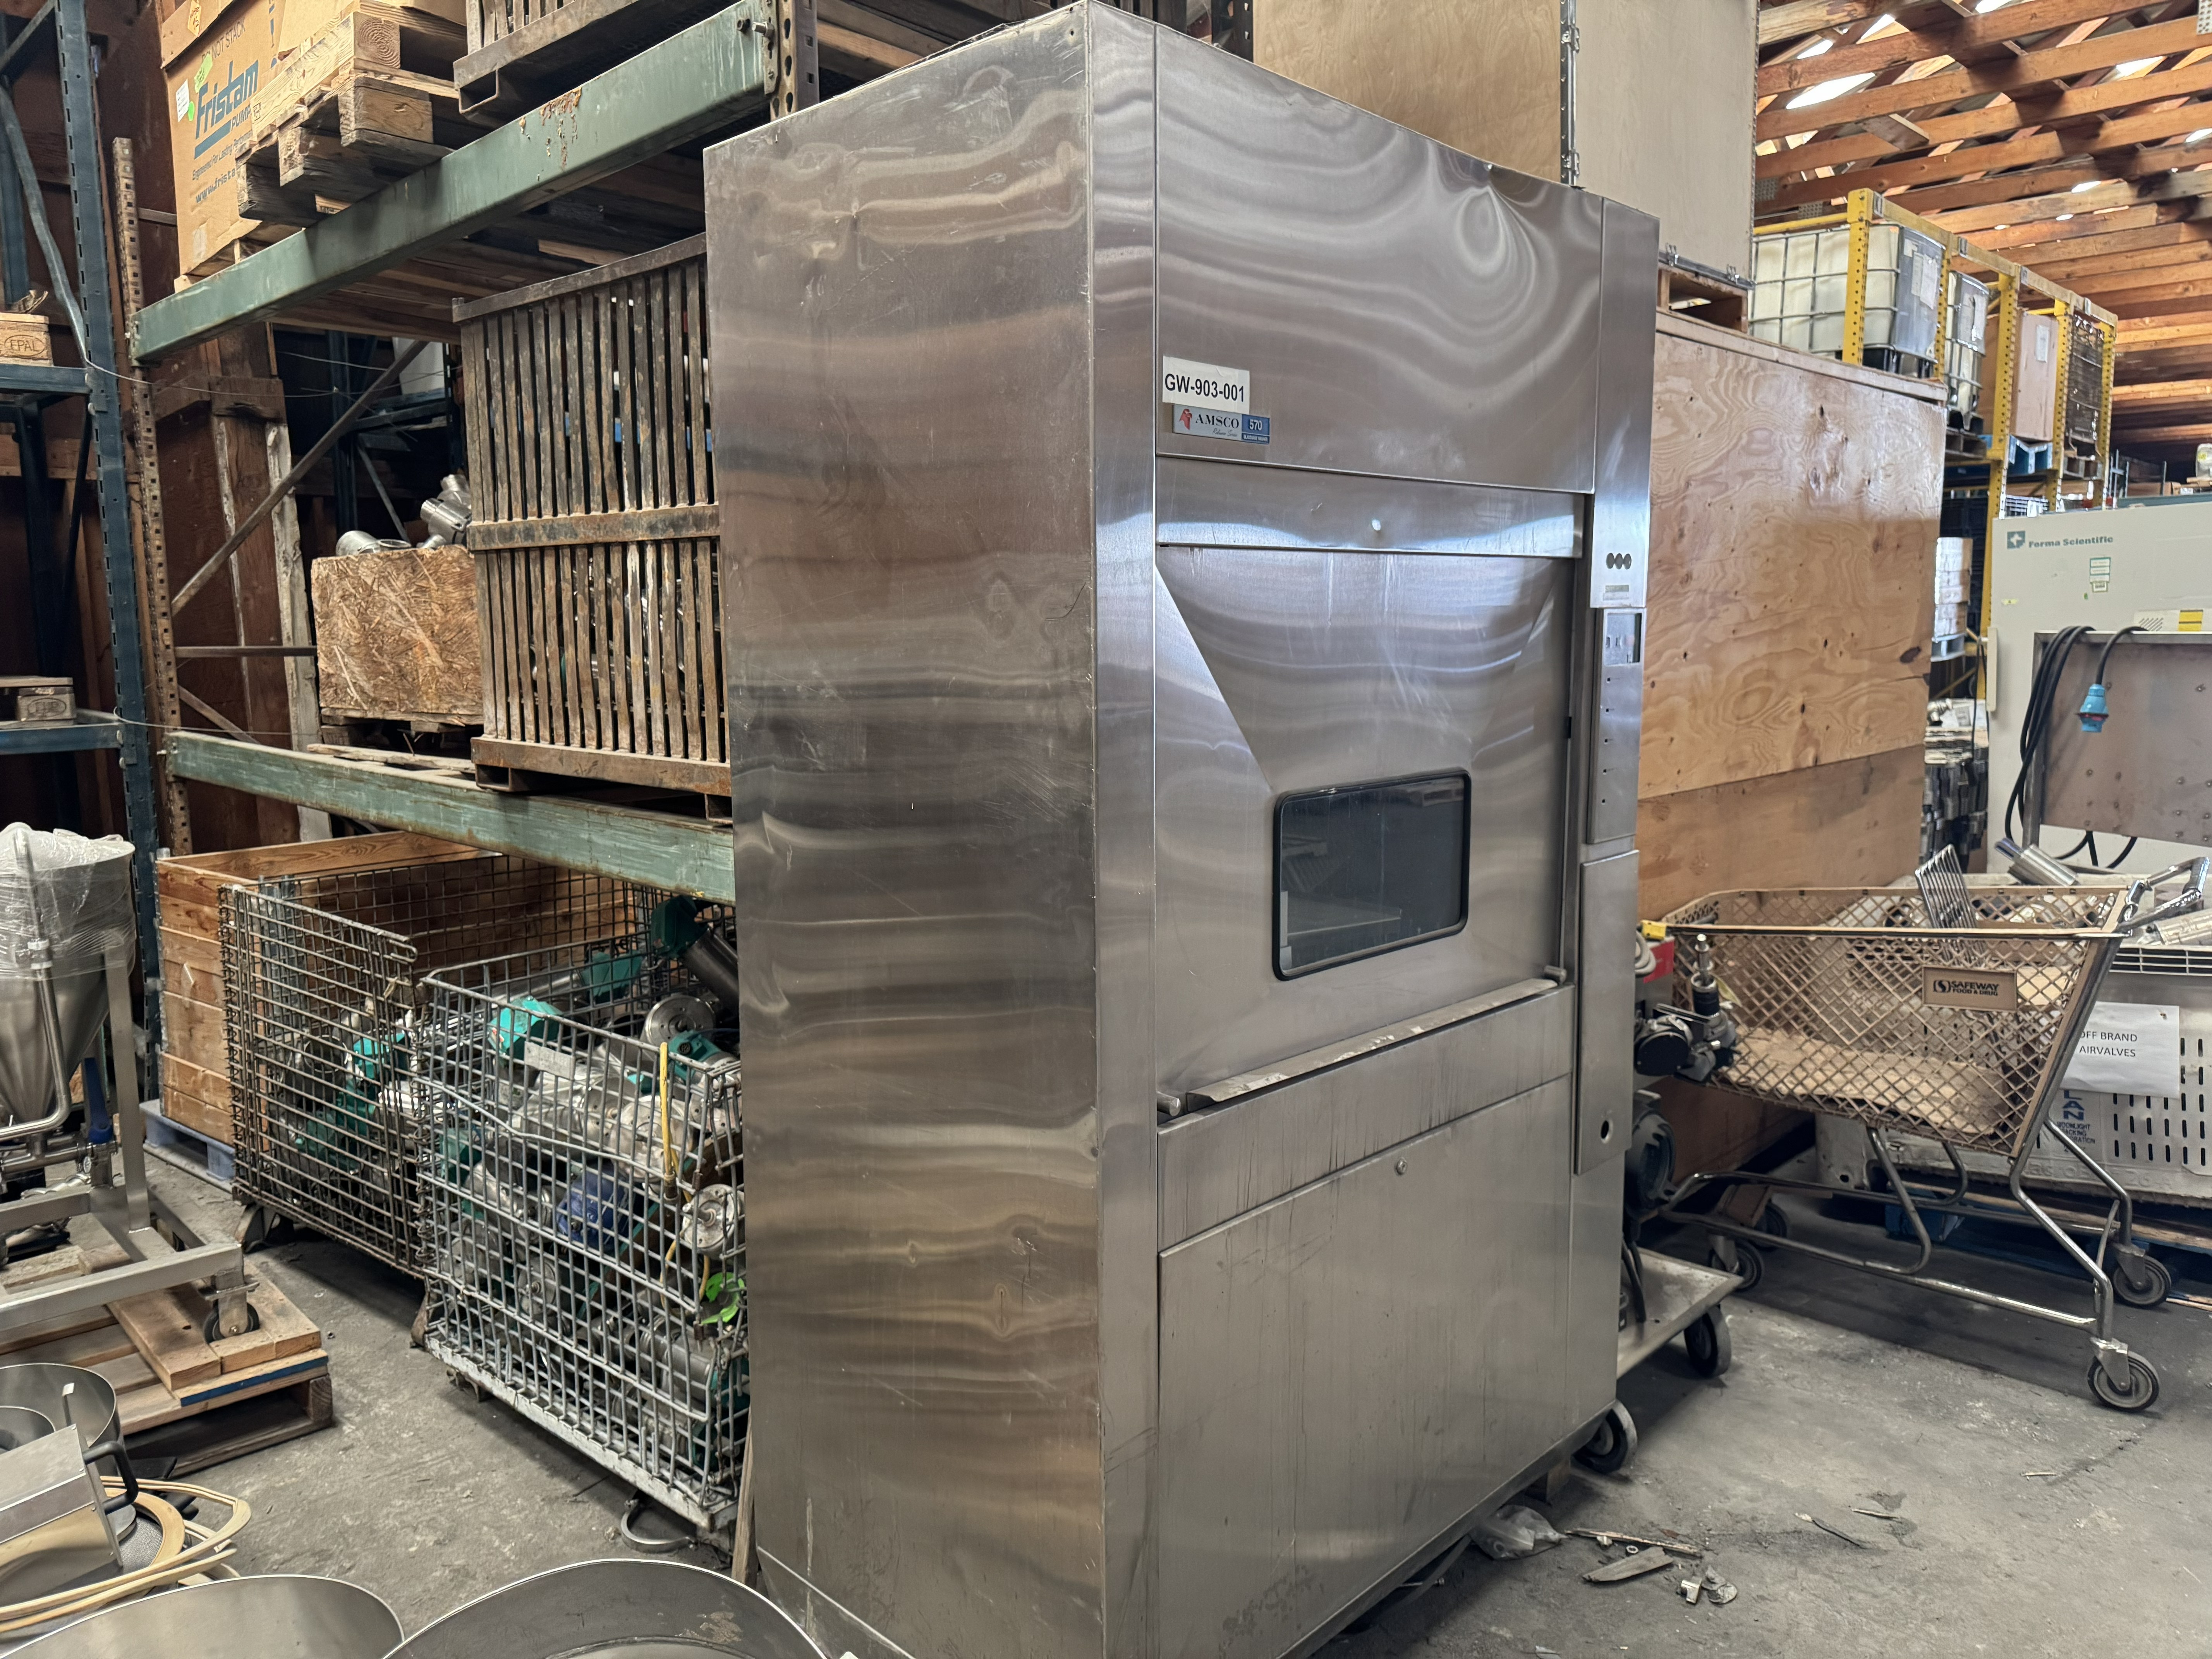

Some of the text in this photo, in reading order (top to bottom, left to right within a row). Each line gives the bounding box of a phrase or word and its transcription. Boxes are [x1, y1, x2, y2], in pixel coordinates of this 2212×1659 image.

[211, 36, 224, 58] NOT
[226, 17, 246, 48] STACK
[196, 59, 259, 140] Fristam
[1165, 373, 1244, 402] GW-903-001
[1195, 413, 1239, 429] AMSCO
[1249, 419, 1262, 431] 570
[2063, 536, 2113, 546] Scientific
[1951, 981, 1999, 991] SAFEWAY
[2101, 1032, 2137, 1042] BRAND
[2079, 1046, 2136, 1057] AIRVALVES
